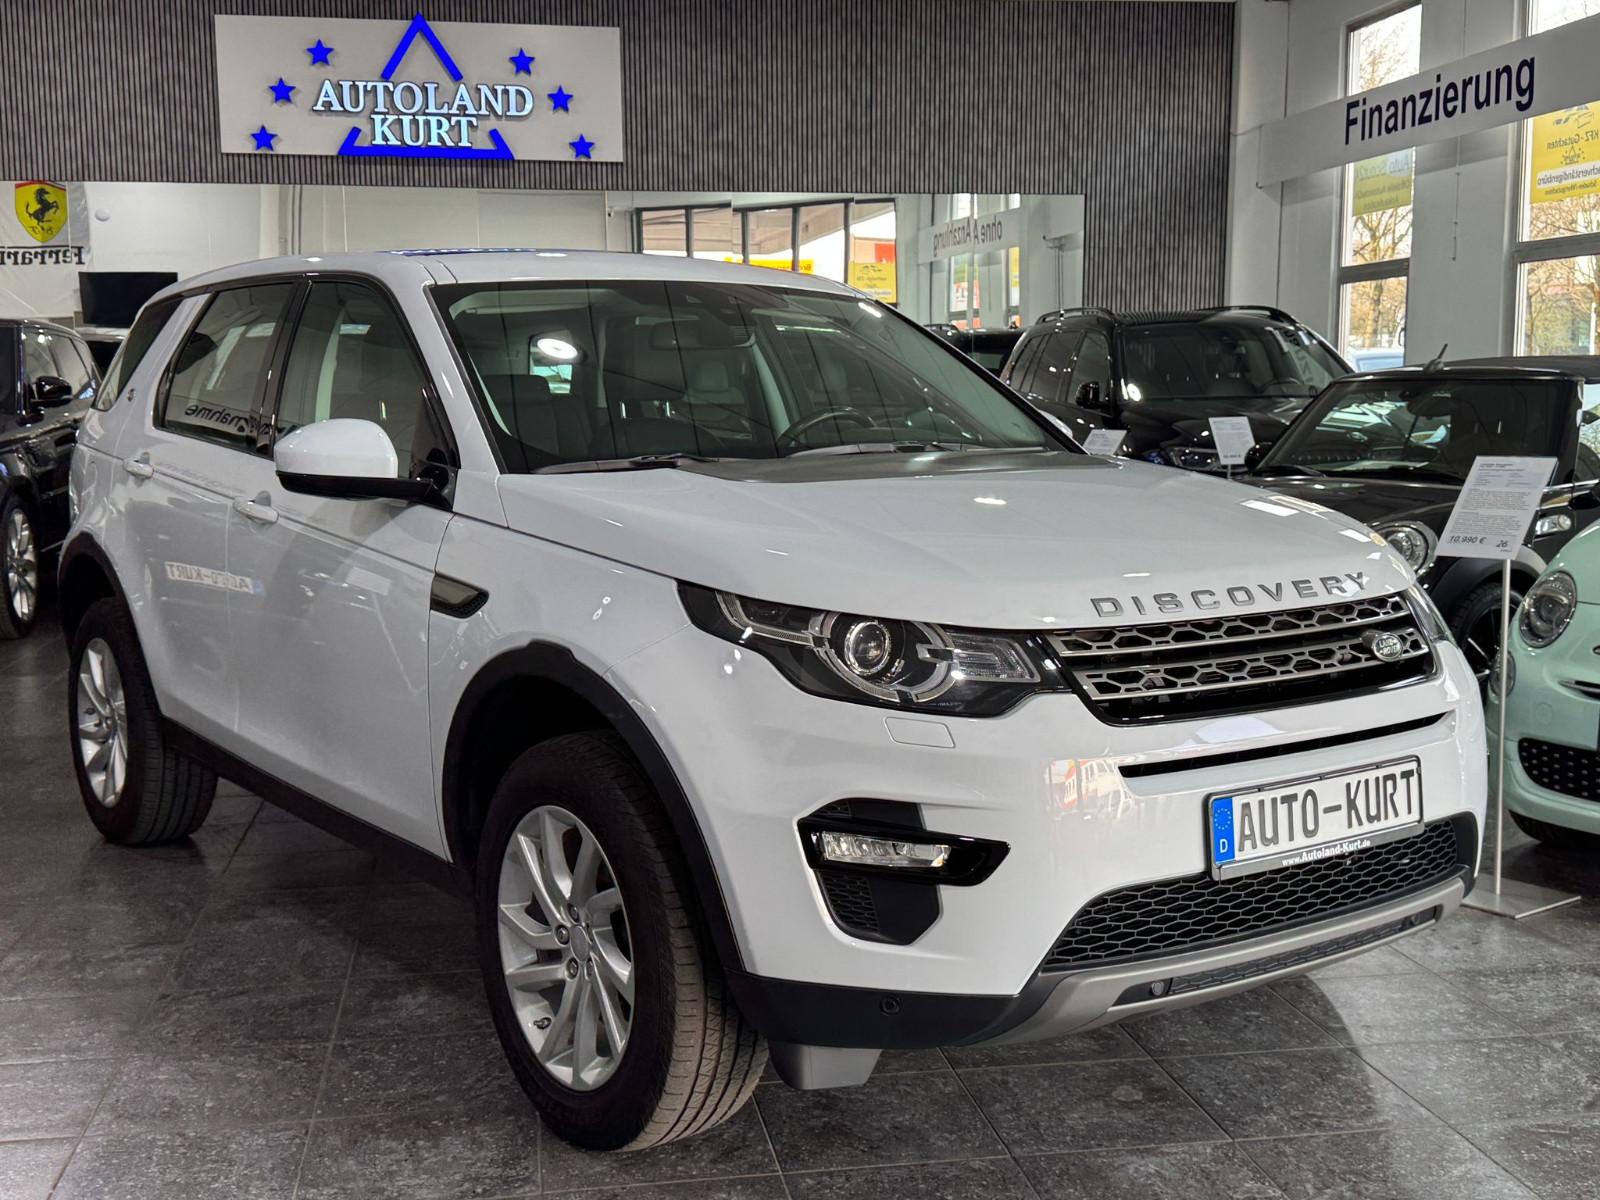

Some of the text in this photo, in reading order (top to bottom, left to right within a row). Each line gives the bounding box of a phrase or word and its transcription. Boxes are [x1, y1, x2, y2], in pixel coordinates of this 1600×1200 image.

[312, 79, 535, 117] AUTOLAND
[1345, 56, 1536, 145] Finanzierung
[370, 114, 478, 148] KURT
[1090, 571, 1366, 618] DISCOVERY
[1219, 769, 1415, 854] D AUTO-KURT
[1282, 838, 1371, 867] www.Autoland-Kurt.de
